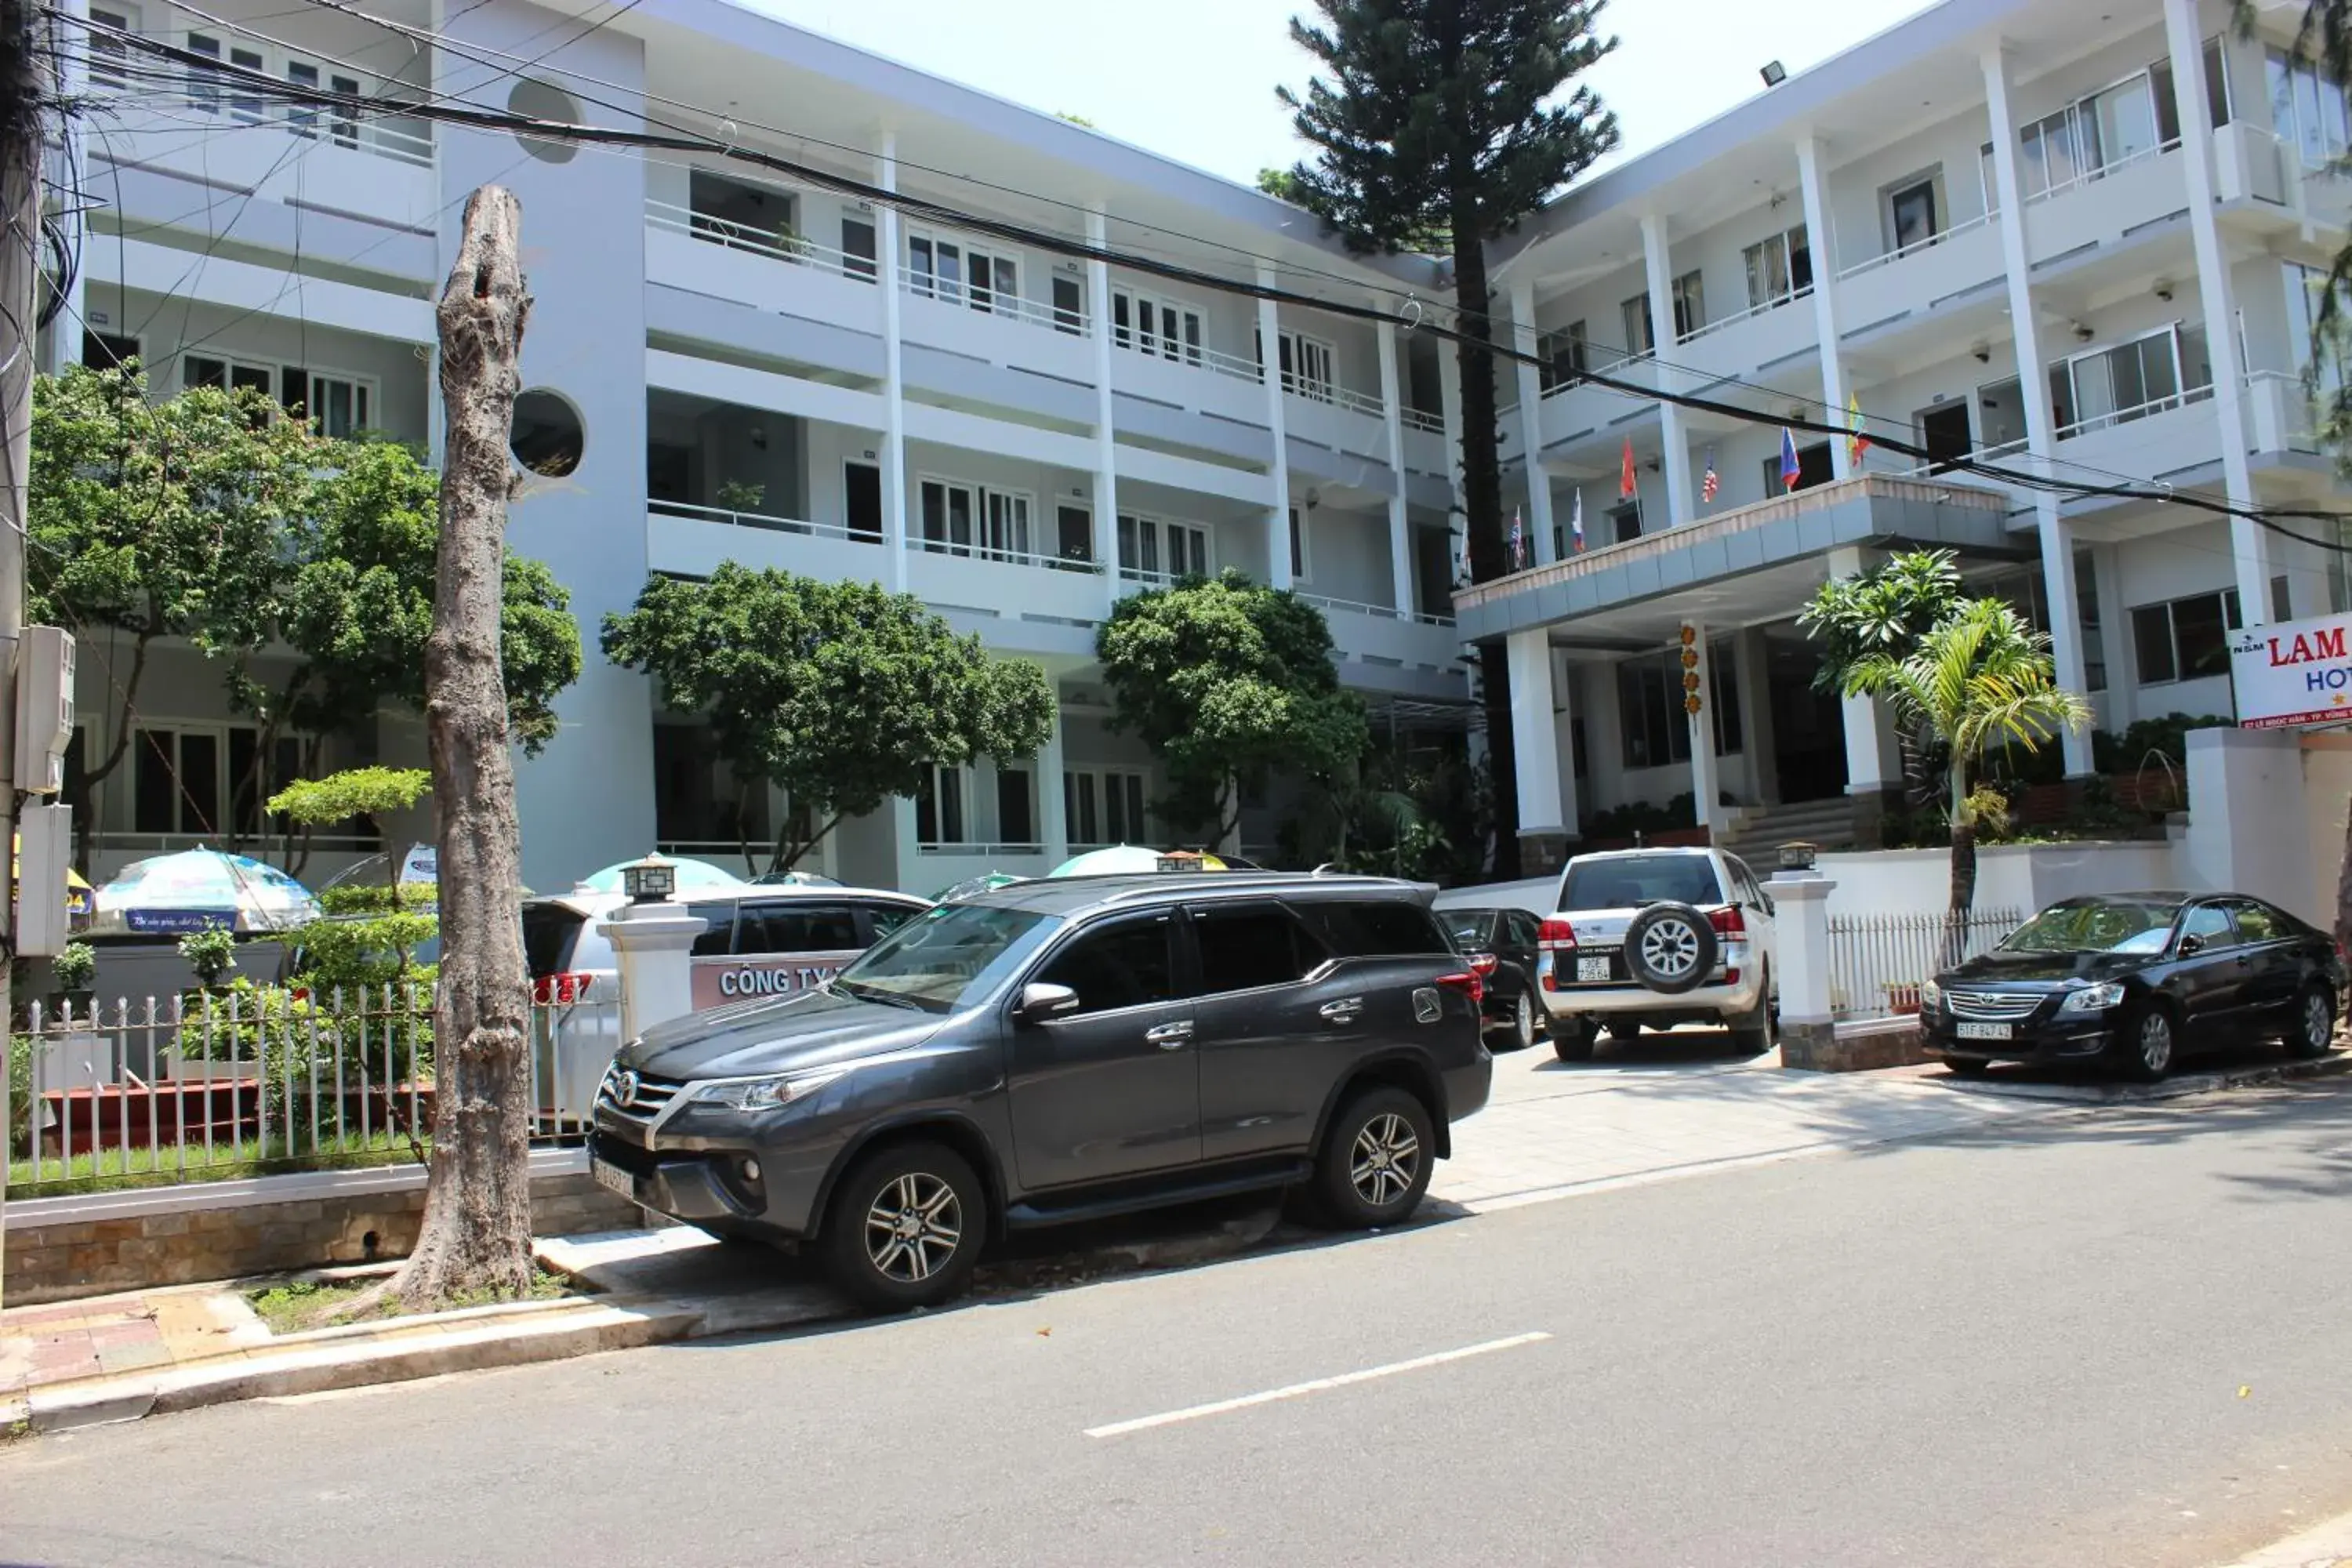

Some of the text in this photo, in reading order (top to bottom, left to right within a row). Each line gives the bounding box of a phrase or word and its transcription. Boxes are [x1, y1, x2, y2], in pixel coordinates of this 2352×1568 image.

[2267, 627, 2347, 666] LAM
[720, 963, 828, 996] CÔNG TY
